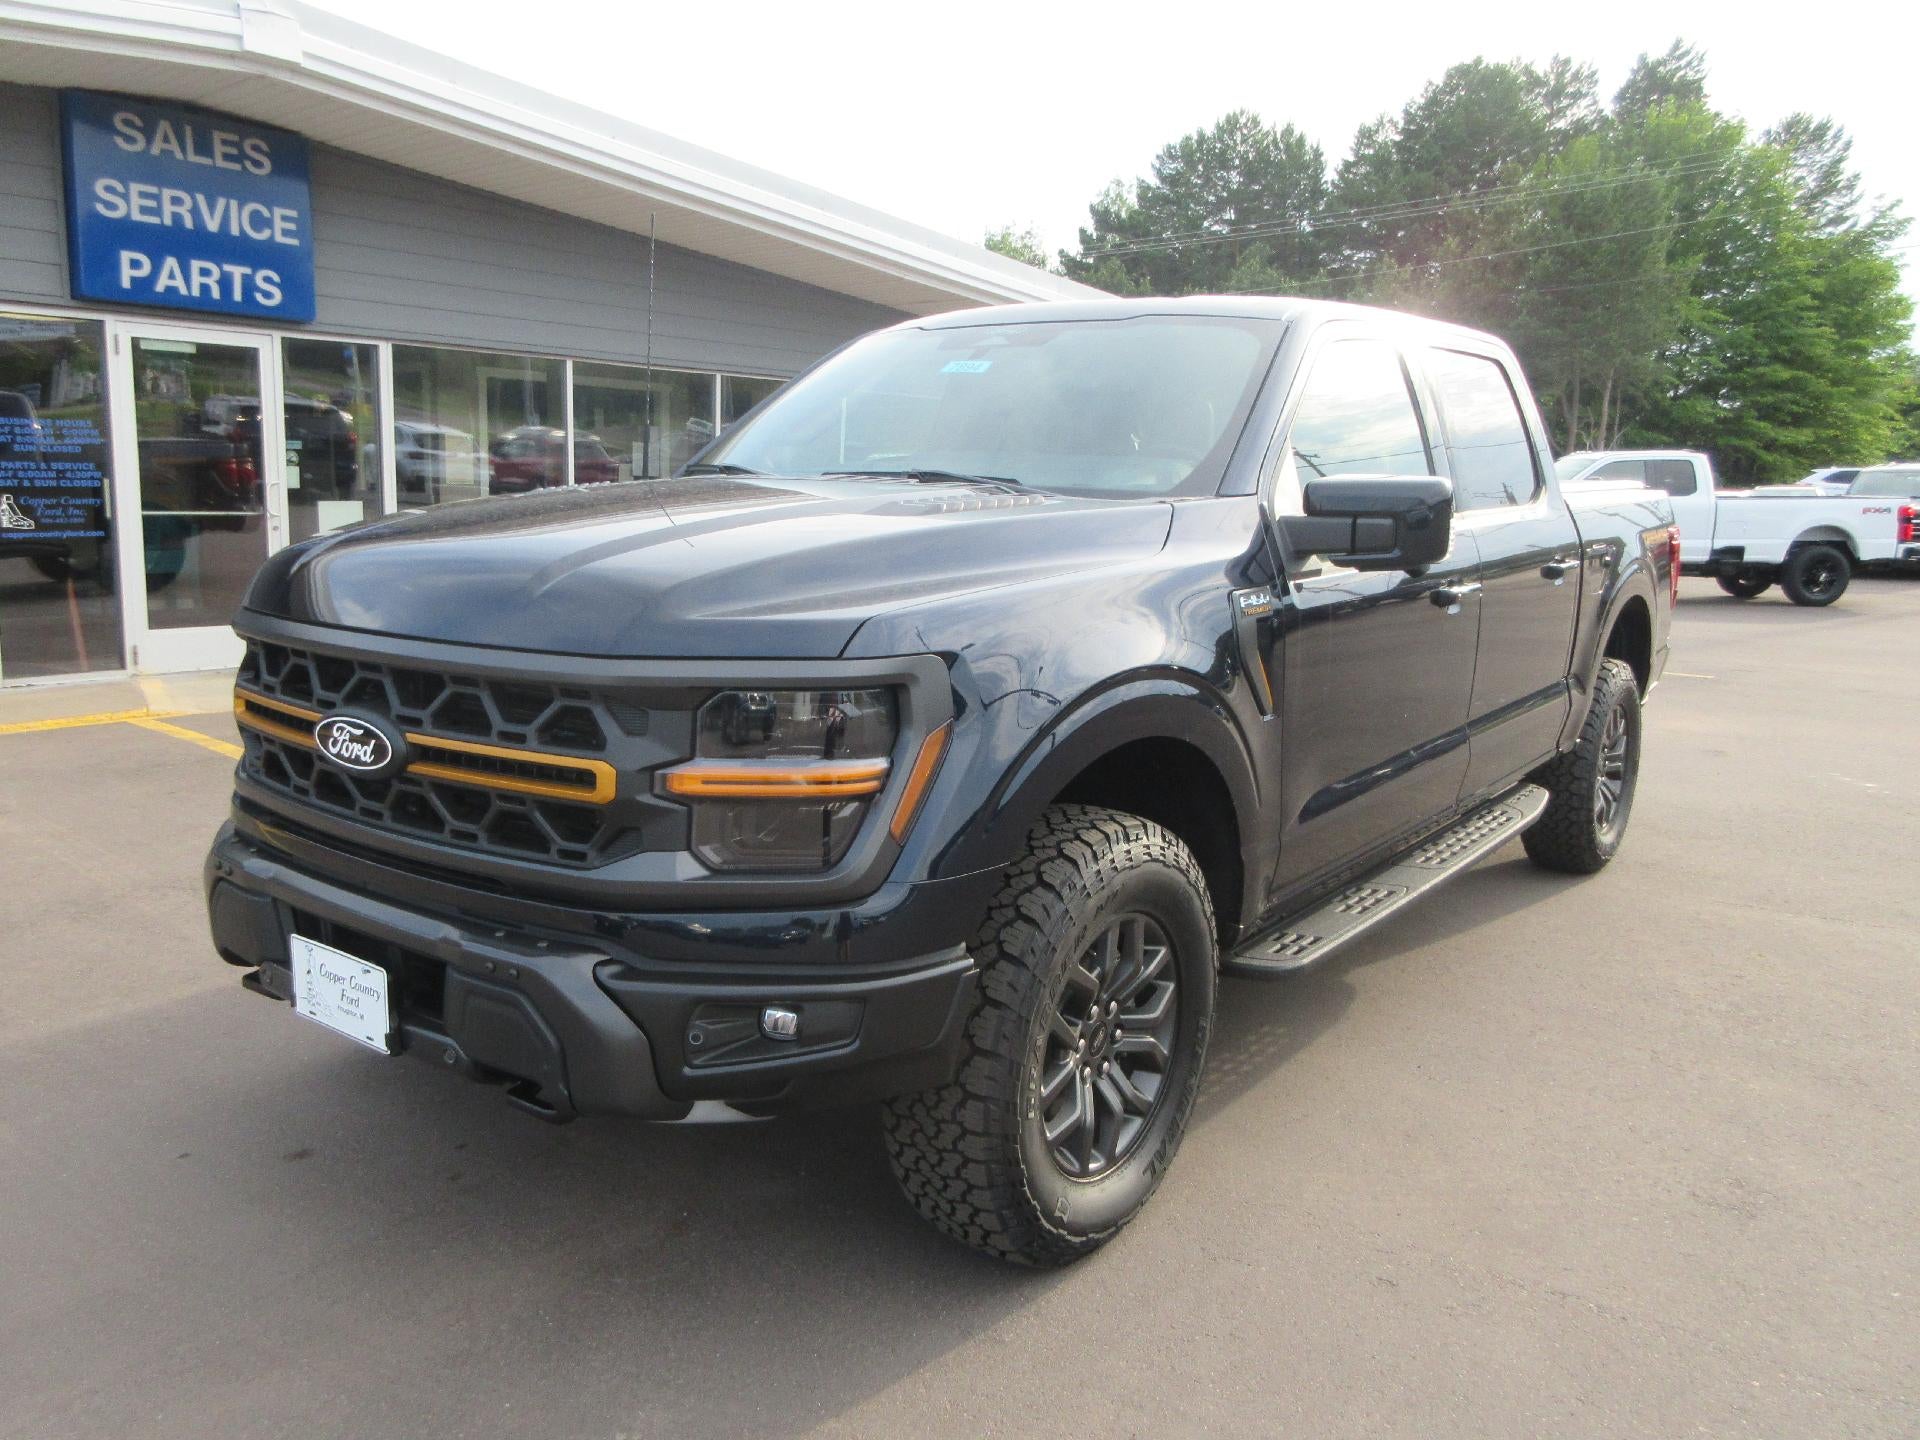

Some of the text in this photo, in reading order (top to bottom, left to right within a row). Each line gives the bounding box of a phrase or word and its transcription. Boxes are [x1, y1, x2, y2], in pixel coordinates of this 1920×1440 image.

[113, 111, 272, 176] SALES
[94, 178, 300, 247] SERVICE
[119, 249, 283, 307] PARTS
[1, 462, 36, 470] PARTS
[51, 462, 96, 470] SERVICE
[14, 444, 81, 453] SUN CLOSED
[20, 496, 103, 507] Copper Country
[328, 722, 376, 764] Ford
[319, 962, 382, 1002] Copper Country
[341, 988, 360, 1009] Ford
